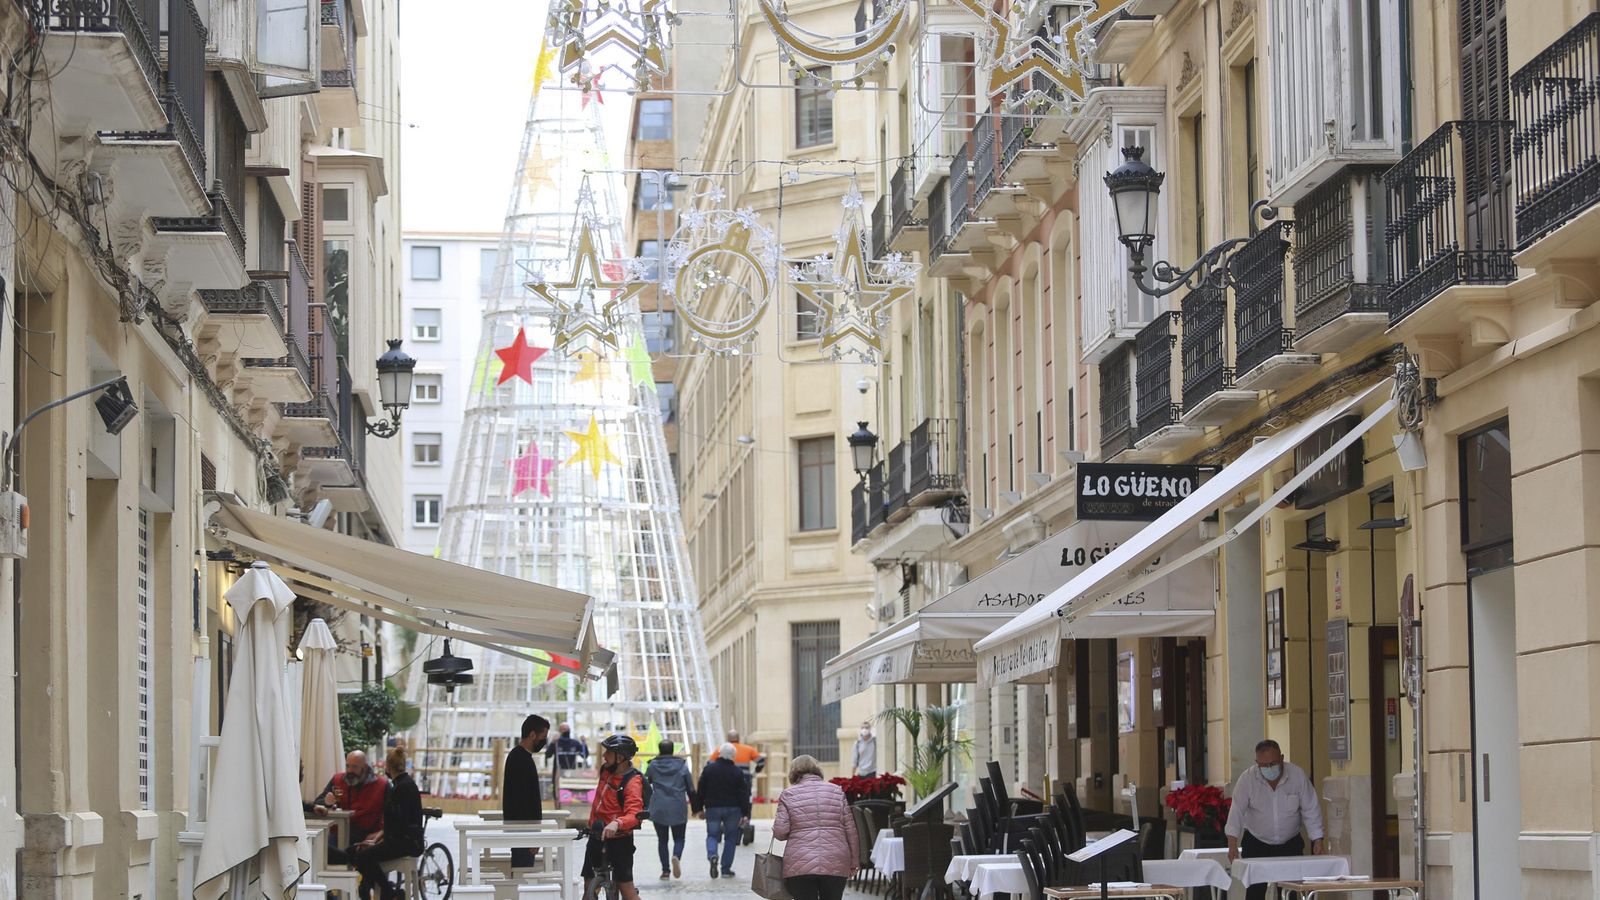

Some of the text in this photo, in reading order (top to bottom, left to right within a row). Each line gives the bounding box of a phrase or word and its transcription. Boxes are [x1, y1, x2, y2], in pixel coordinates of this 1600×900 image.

[1082, 471, 1192, 498] LO GÜENO
[1142, 497, 1152, 506] de
[1060, 547, 1086, 567] LO
